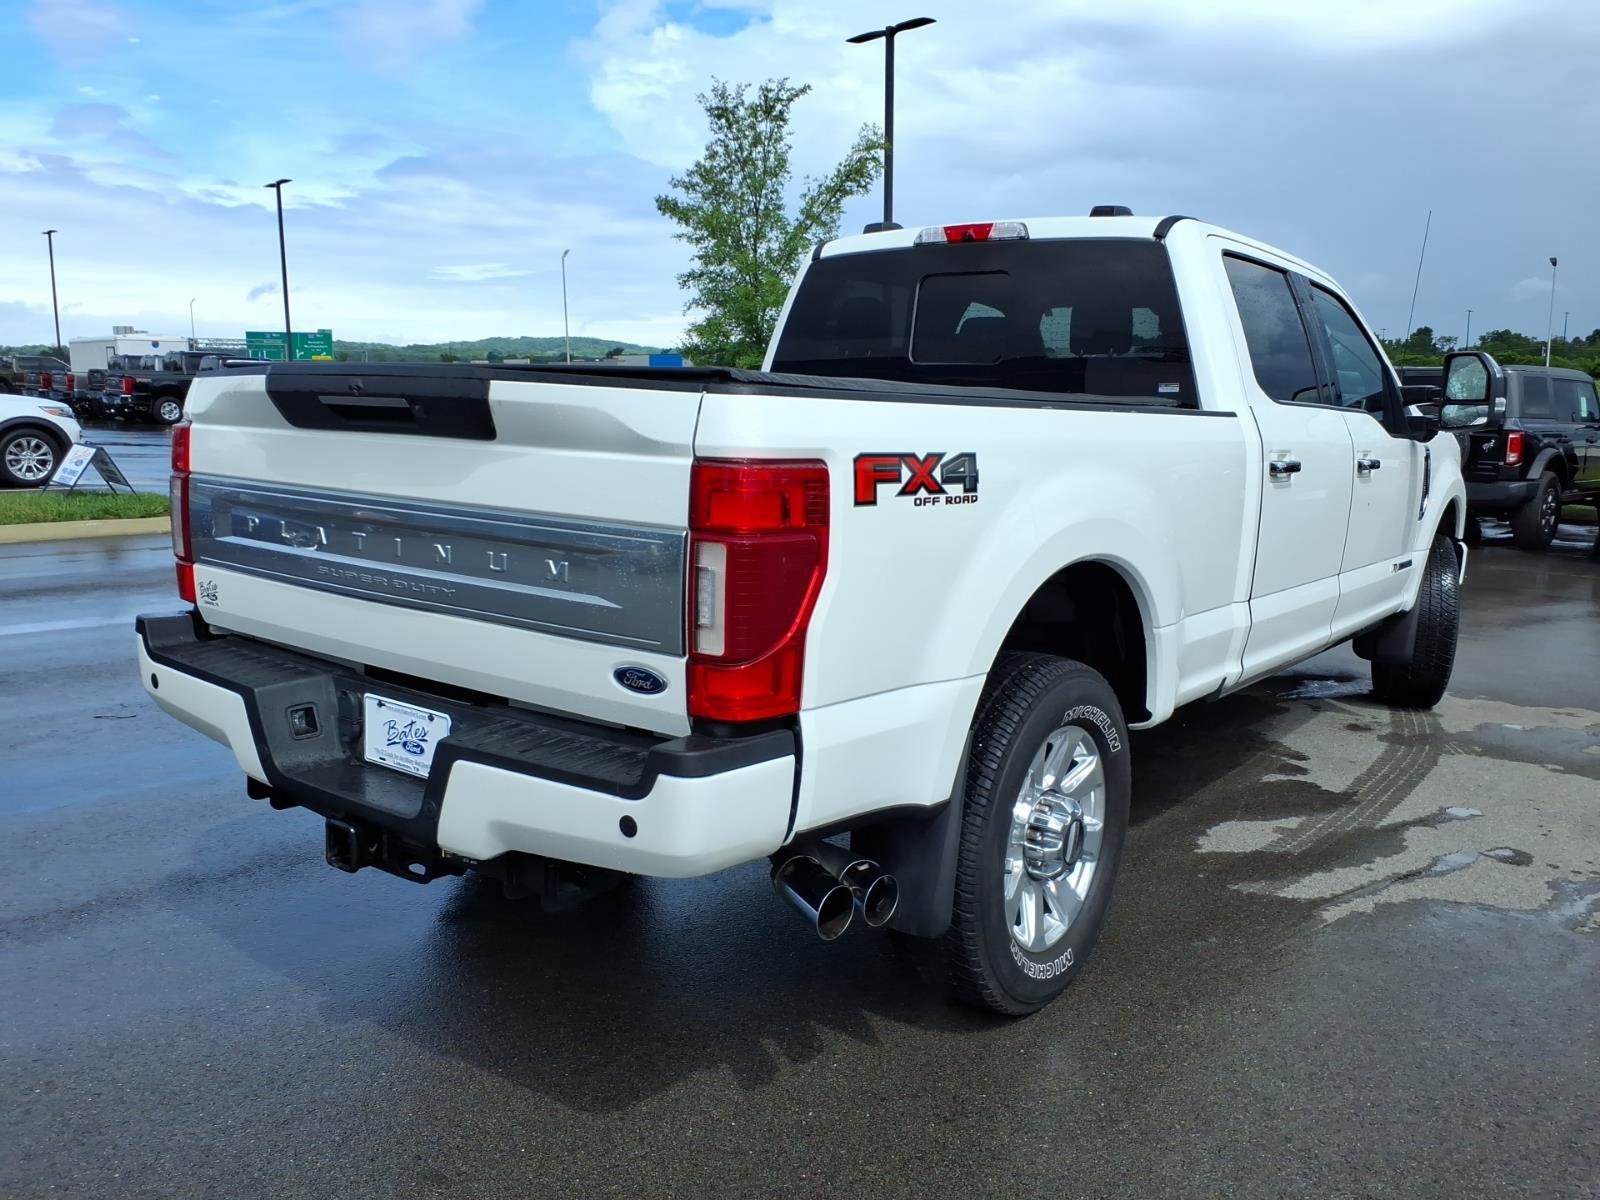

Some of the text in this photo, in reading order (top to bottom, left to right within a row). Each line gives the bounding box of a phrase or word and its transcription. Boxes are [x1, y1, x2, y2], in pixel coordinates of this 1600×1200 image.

[853, 452, 979, 507] FX4
[913, 494, 979, 507] OFF ROAD
[246, 514, 569, 583] PLATINUM
[317, 565, 456, 597] SUPER DUTY
[622, 670, 656, 690] Ford
[383, 719, 429, 741] Bates
[1061, 705, 1121, 752] MICHELIN
[1010, 939, 1074, 979] MICHELIN
